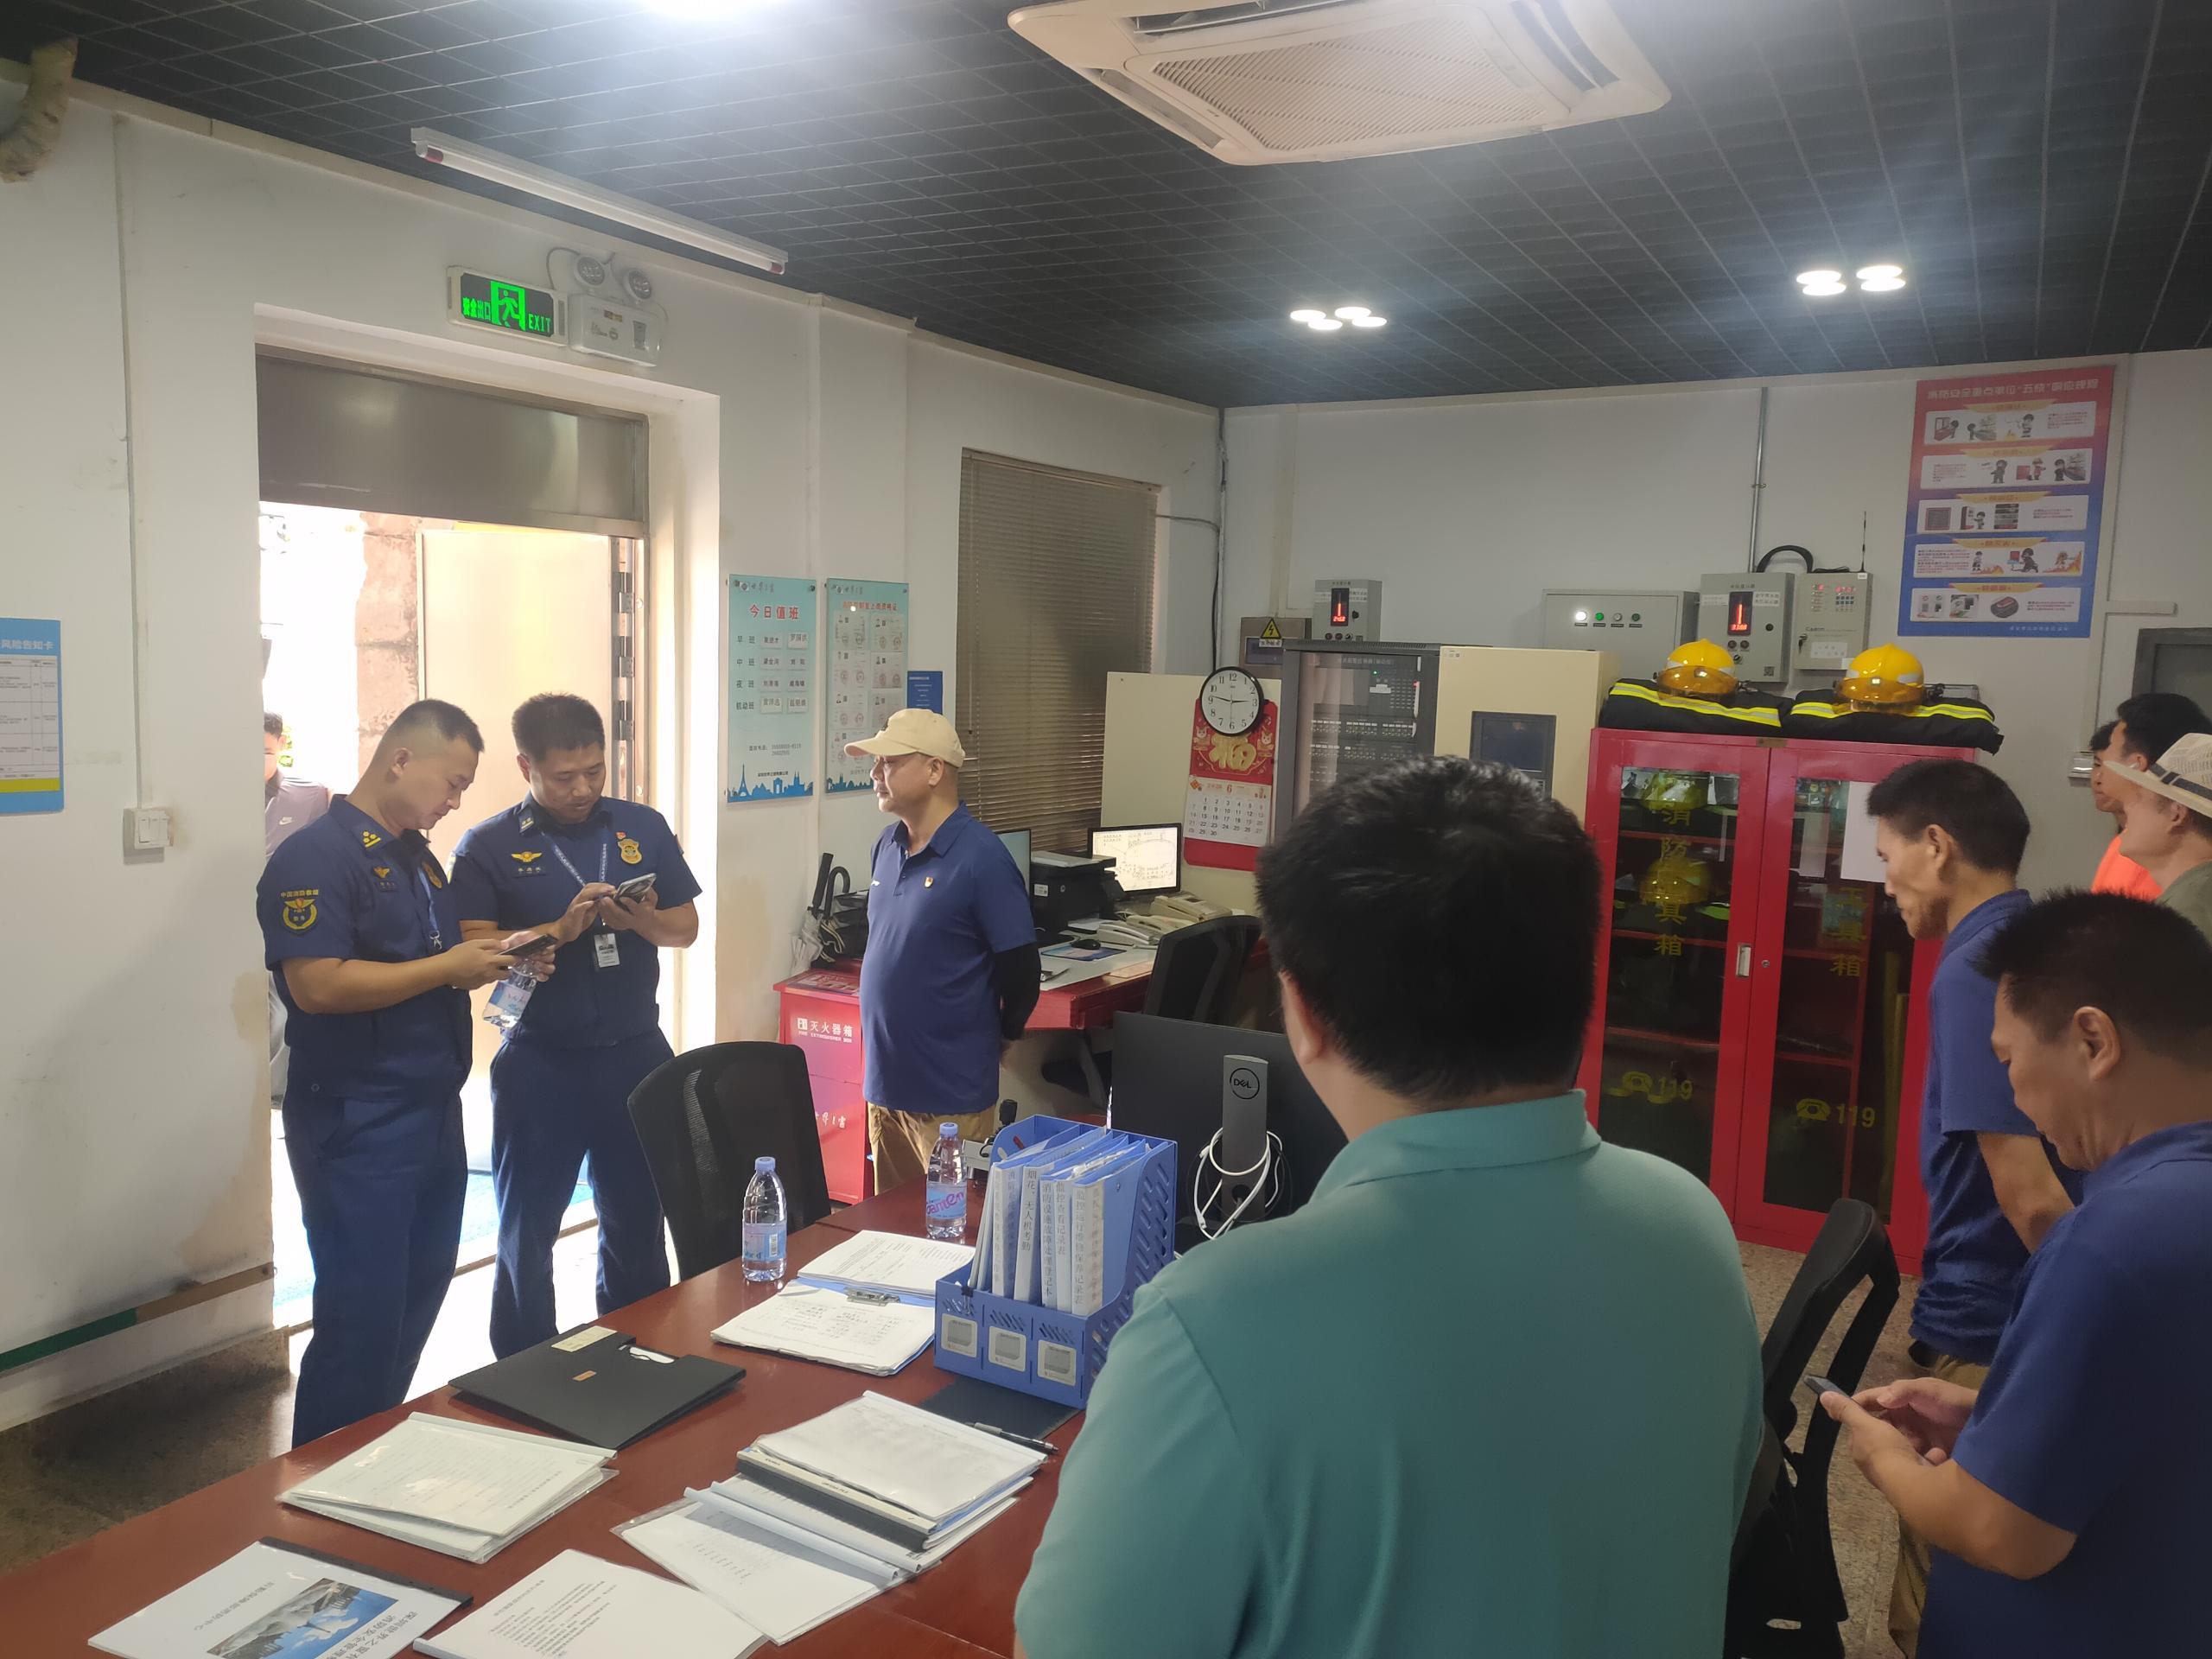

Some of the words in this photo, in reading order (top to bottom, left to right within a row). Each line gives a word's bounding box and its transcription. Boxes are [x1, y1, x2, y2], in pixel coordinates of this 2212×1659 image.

[462, 296, 491, 321] 安全出口
[528, 313, 551, 334] EXIT
[750, 604, 799, 620] 今日值班
[1227, 785, 1232, 793] 6
[1654, 804, 1692, 957] 消防具箱
[810, 1020, 853, 1038] 灭火器箱
[1234, 1078, 1255, 1089] DEL
[1658, 1077, 1694, 1101] 119
[1836, 1104, 1876, 1128] 119
[1021, 1169, 1037, 1251] 烟花、无人机考勤
